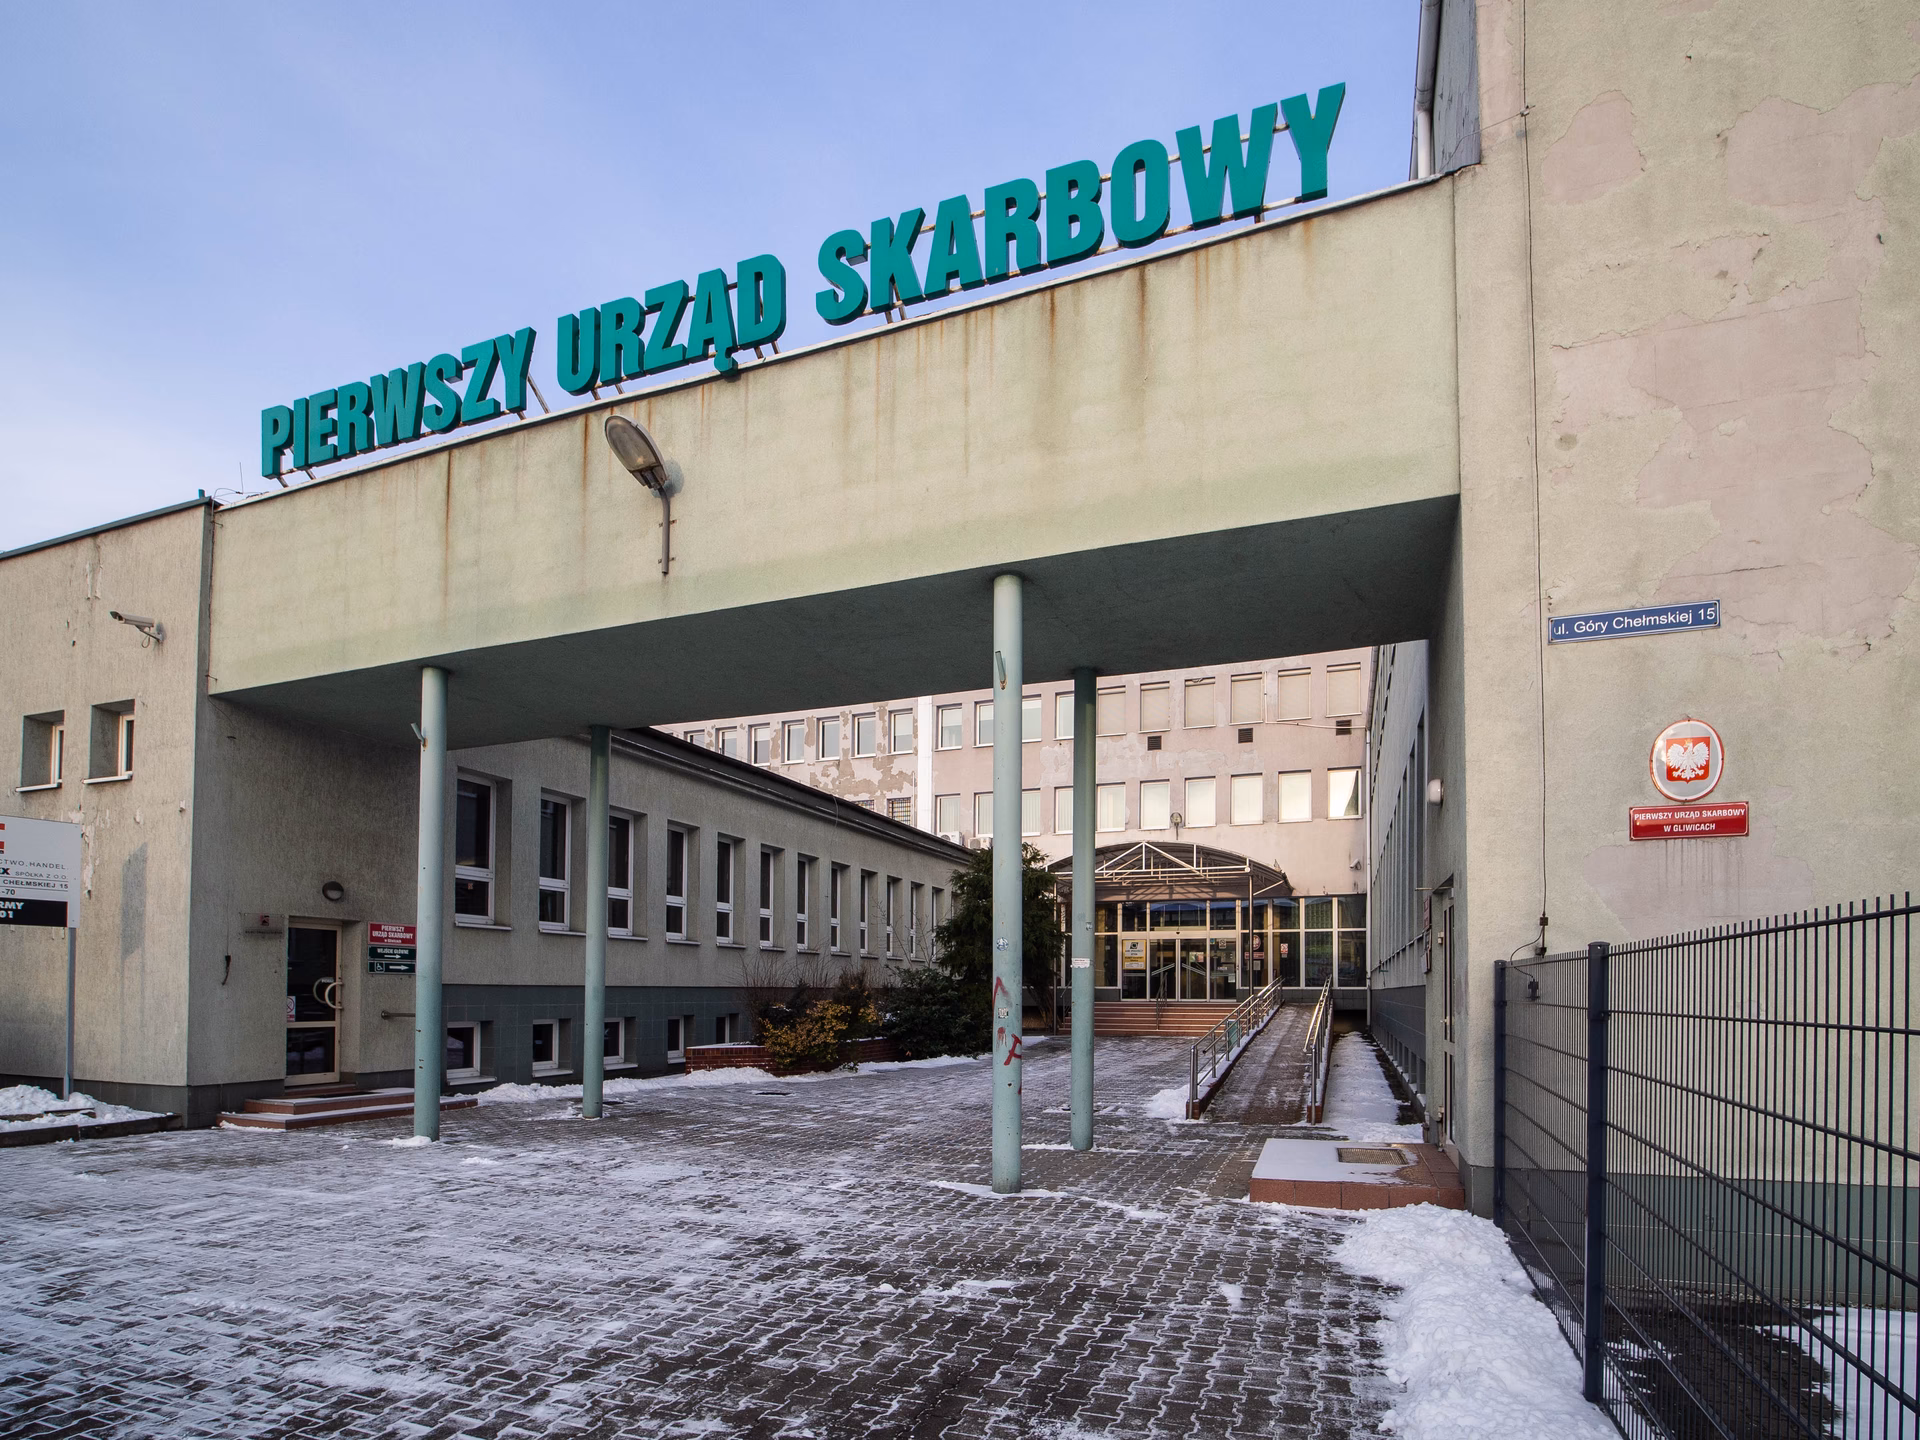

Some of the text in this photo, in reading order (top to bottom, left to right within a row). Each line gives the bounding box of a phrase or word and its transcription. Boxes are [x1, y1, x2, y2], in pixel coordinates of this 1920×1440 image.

[262, 82, 1346, 479] PIERWSZY URZĄD SKARBOWY
[1553, 607, 1716, 636] ul. Góry Chełmskiej 15
[1634, 808, 1745, 821] PIERWSZY URZĄD SKARBOWY
[1663, 823, 1716, 833] W GLIWICACH
[3, 879, 56, 889] CHEŁMSKIEJ
